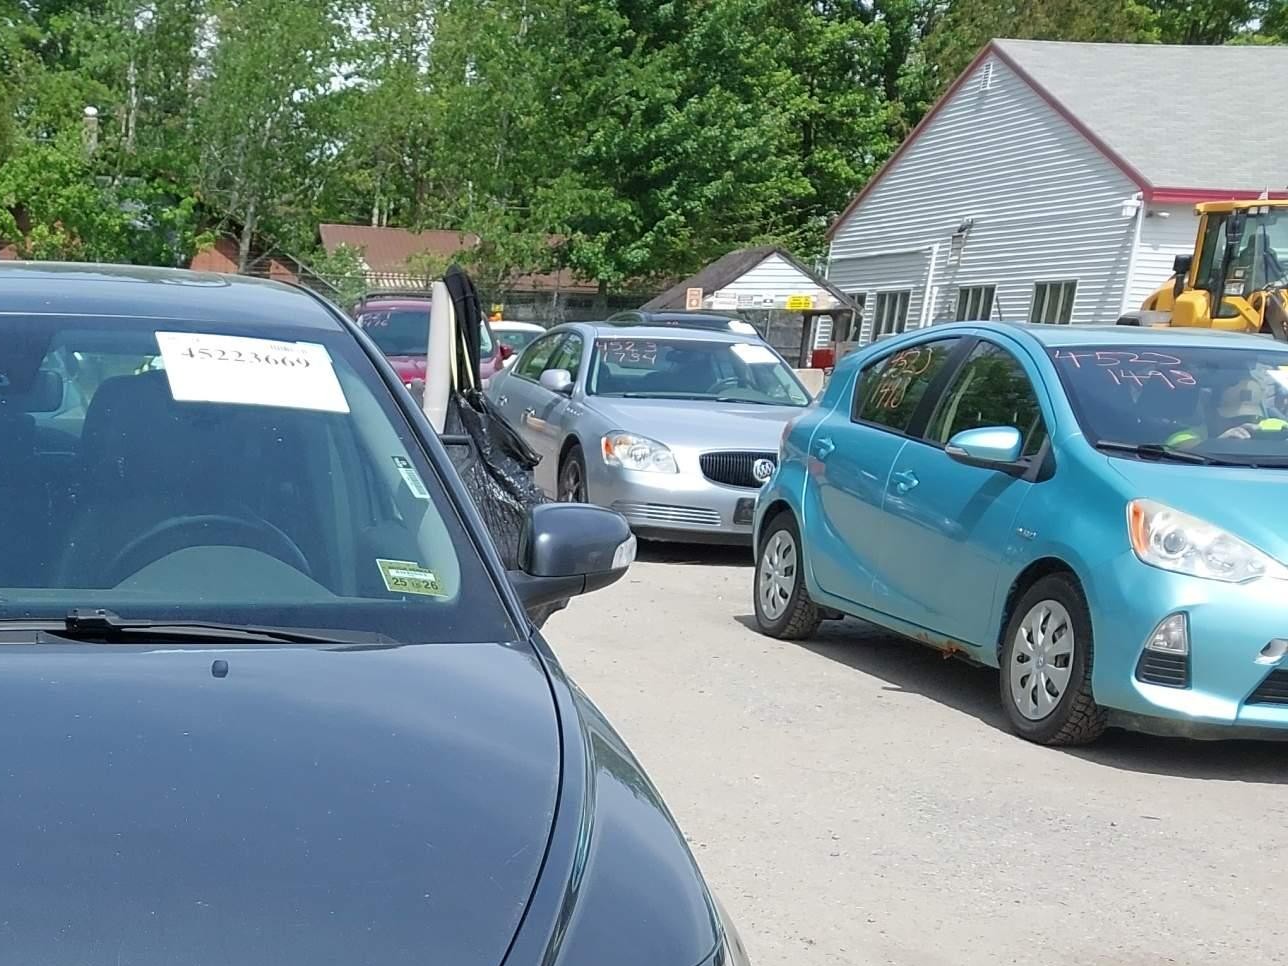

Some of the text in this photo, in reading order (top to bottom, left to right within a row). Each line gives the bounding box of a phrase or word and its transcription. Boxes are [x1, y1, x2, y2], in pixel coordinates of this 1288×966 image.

[595, 340, 657, 352] 4523
[181, 346, 311, 368] 45223669
[1054, 350, 1182, 368] 4522
